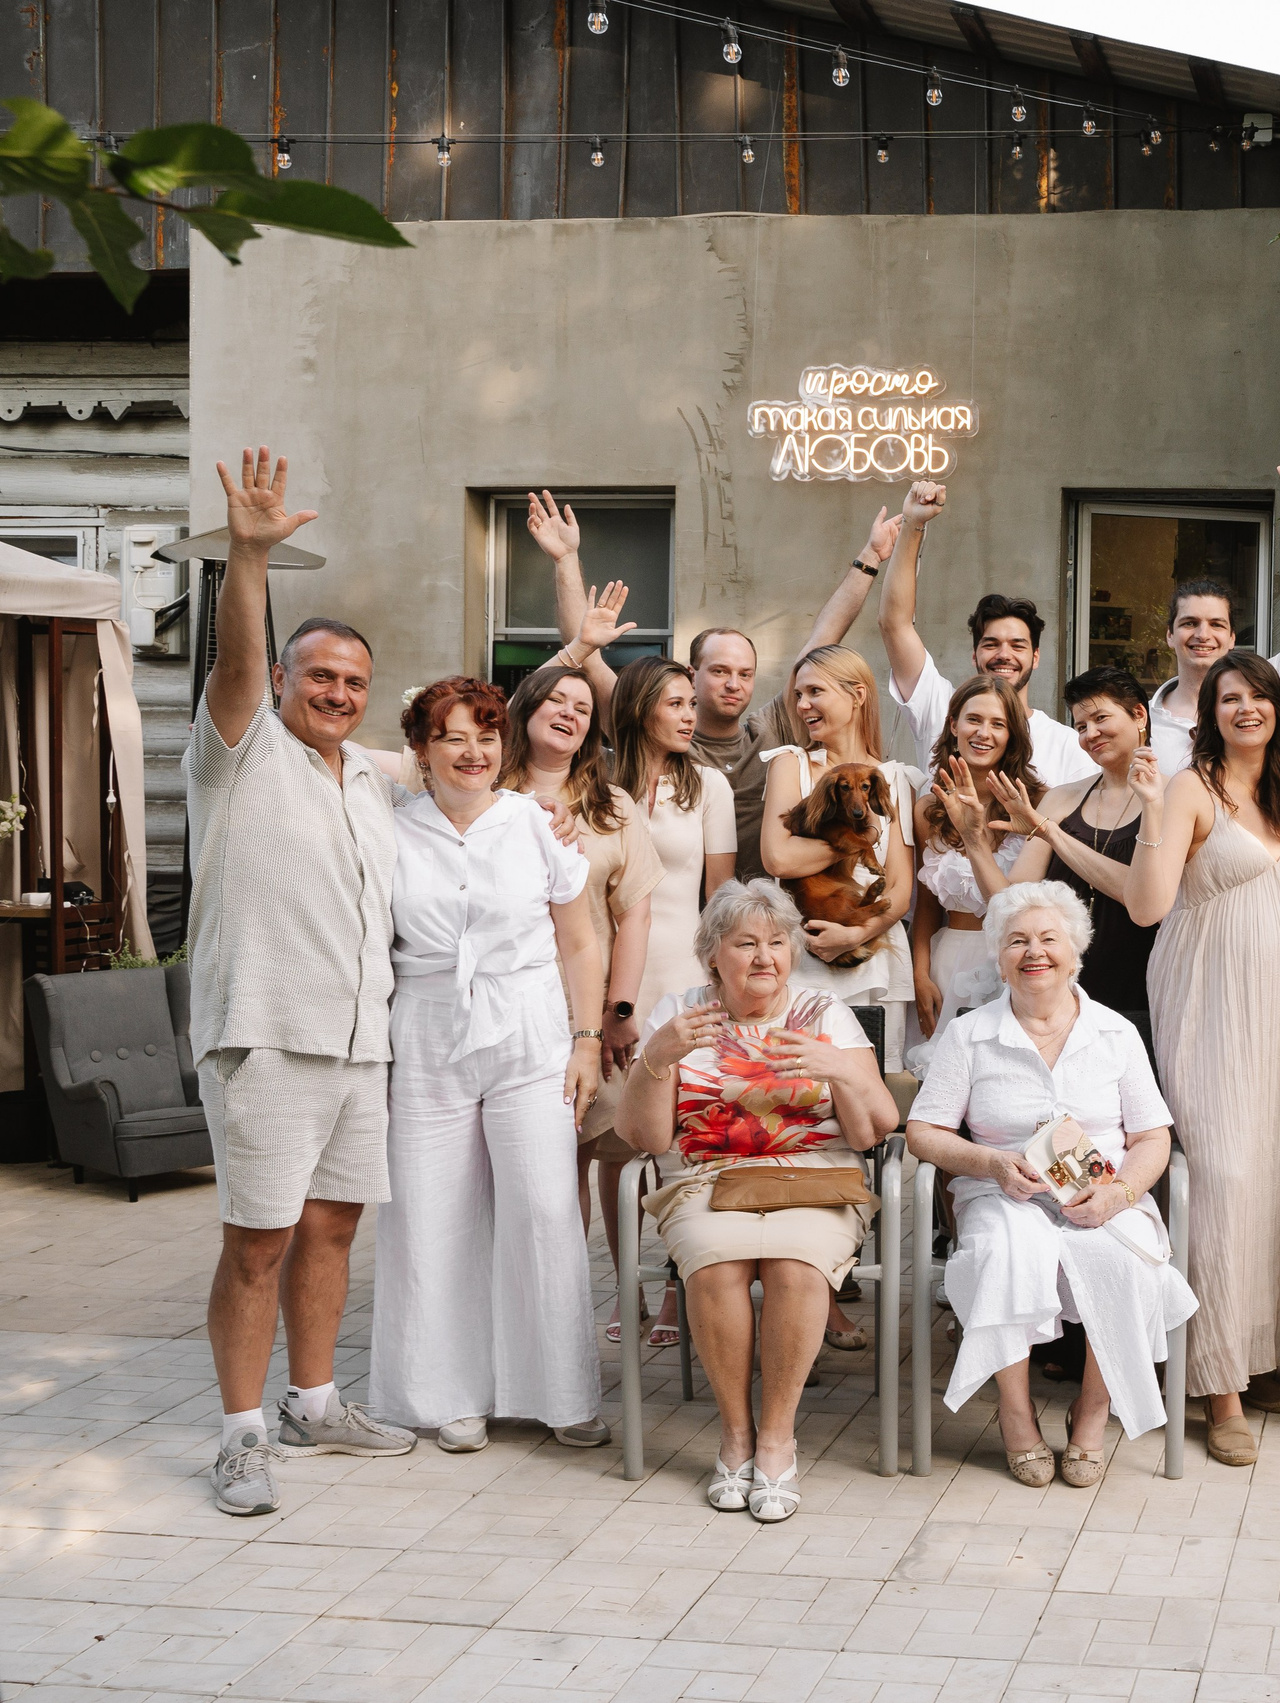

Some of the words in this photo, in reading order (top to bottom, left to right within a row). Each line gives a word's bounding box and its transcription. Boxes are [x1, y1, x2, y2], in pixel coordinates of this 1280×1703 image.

[804, 369, 939, 403] просто
[753, 406, 853, 431] такая
[857, 406, 971, 431] сильная
[775, 433, 950, 474] ЛЮБОВЬ
